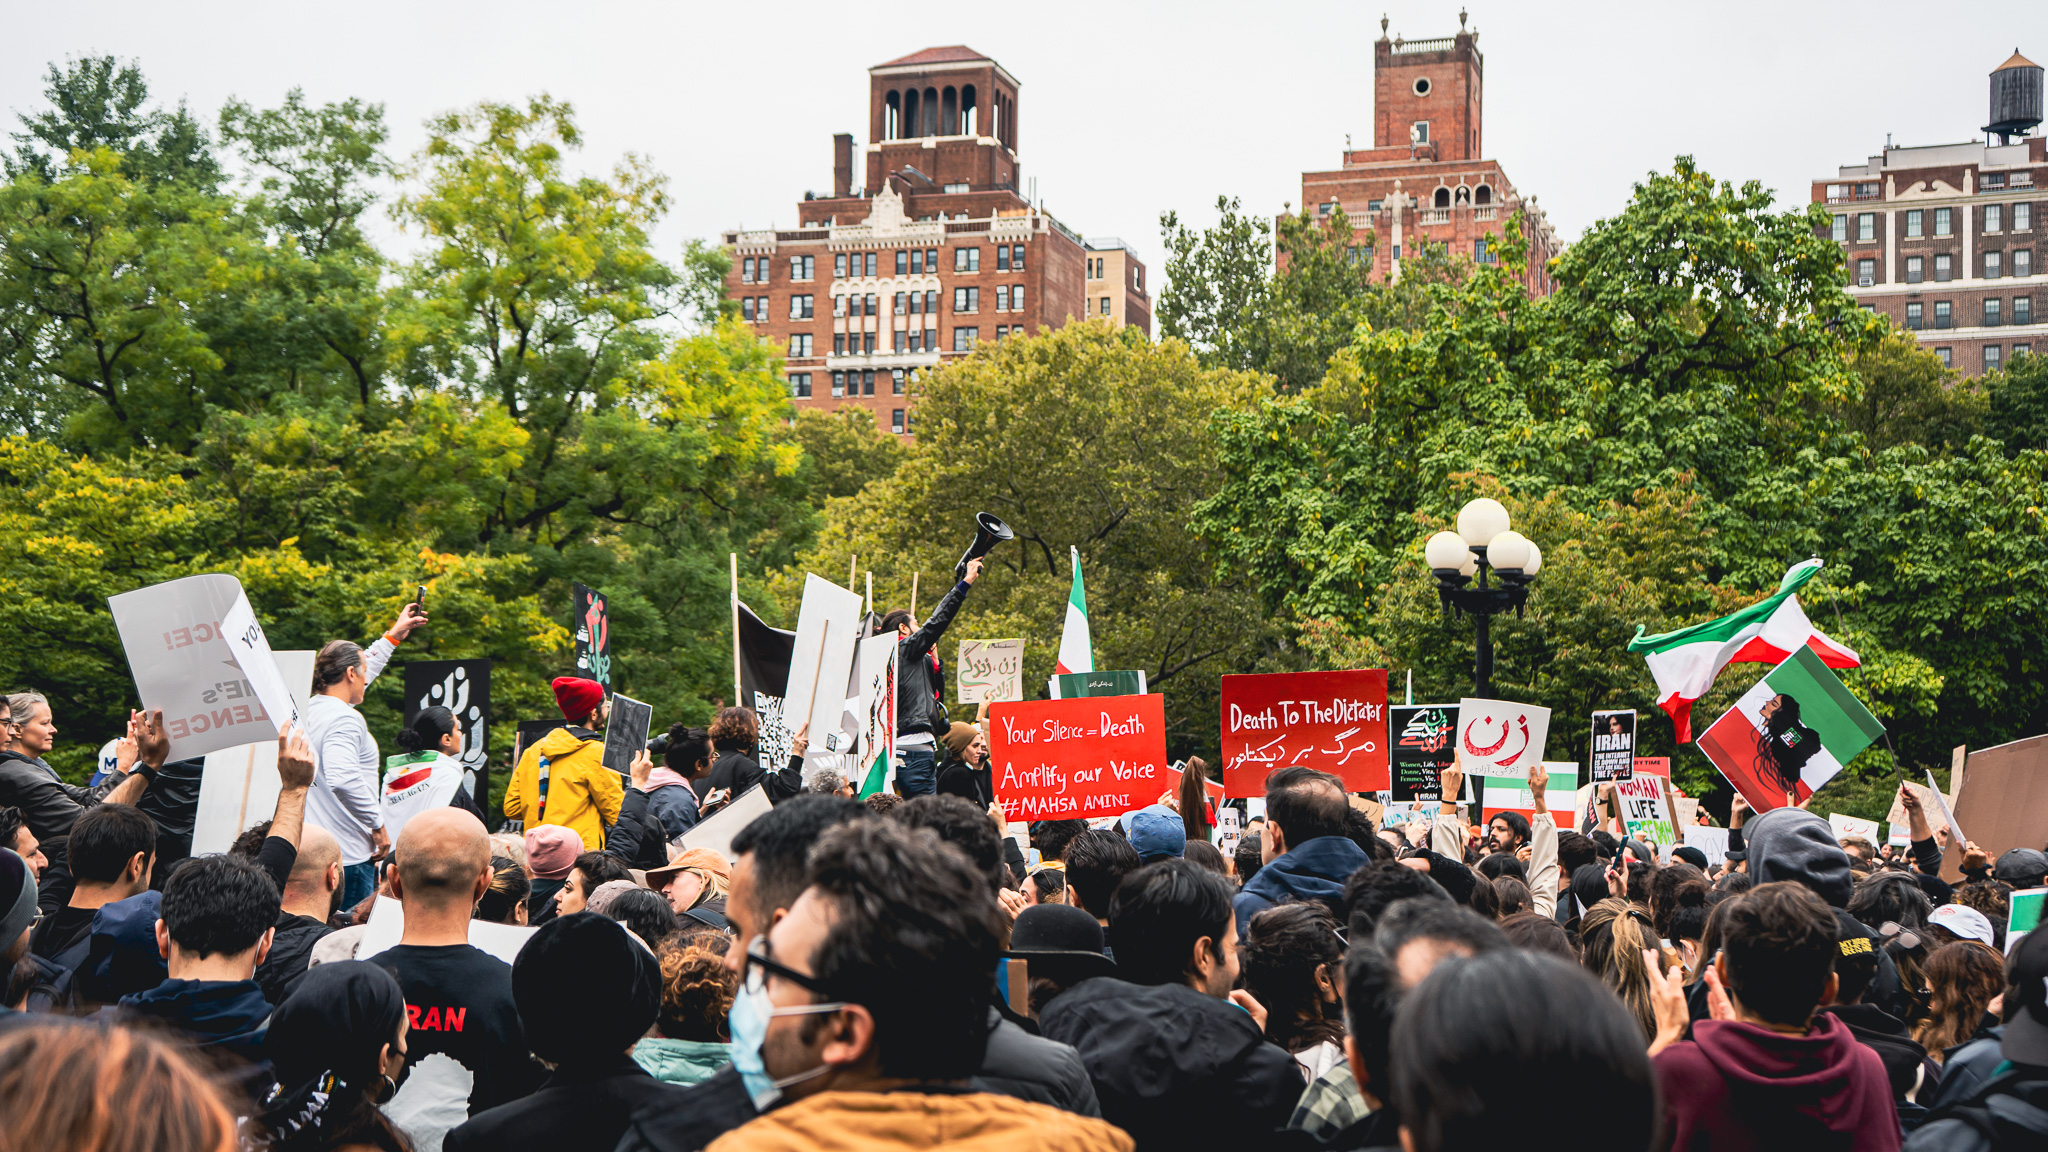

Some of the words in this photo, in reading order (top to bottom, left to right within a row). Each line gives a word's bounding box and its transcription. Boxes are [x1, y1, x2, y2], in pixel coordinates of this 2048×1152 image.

[1002, 716, 1036, 745] Your
[1043, 719, 1083, 742] Silence
[1100, 712, 1145, 738] Death
[1230, 703, 1278, 733] Death
[1278, 701, 1300, 727] To
[1226, 733, 1287, 770] دیکتاتور
[1321, 727, 1375, 766] مرگ
[1464, 714, 1529, 767] زن
[1596, 733, 1631, 751] IRAN
[1291, 745, 1314, 765] بر
[1074, 767, 1102, 784] our
[1110, 760, 1155, 781] Voice
[1594, 770, 1606, 778] THE
[1618, 778, 1660, 800] WOMAN
[1000, 796, 1077, 818] #MAHSA
[1084, 794, 1131, 811] AMINI
[1629, 800, 1659, 819] LIFE
[406, 1004, 467, 1032] RAN
